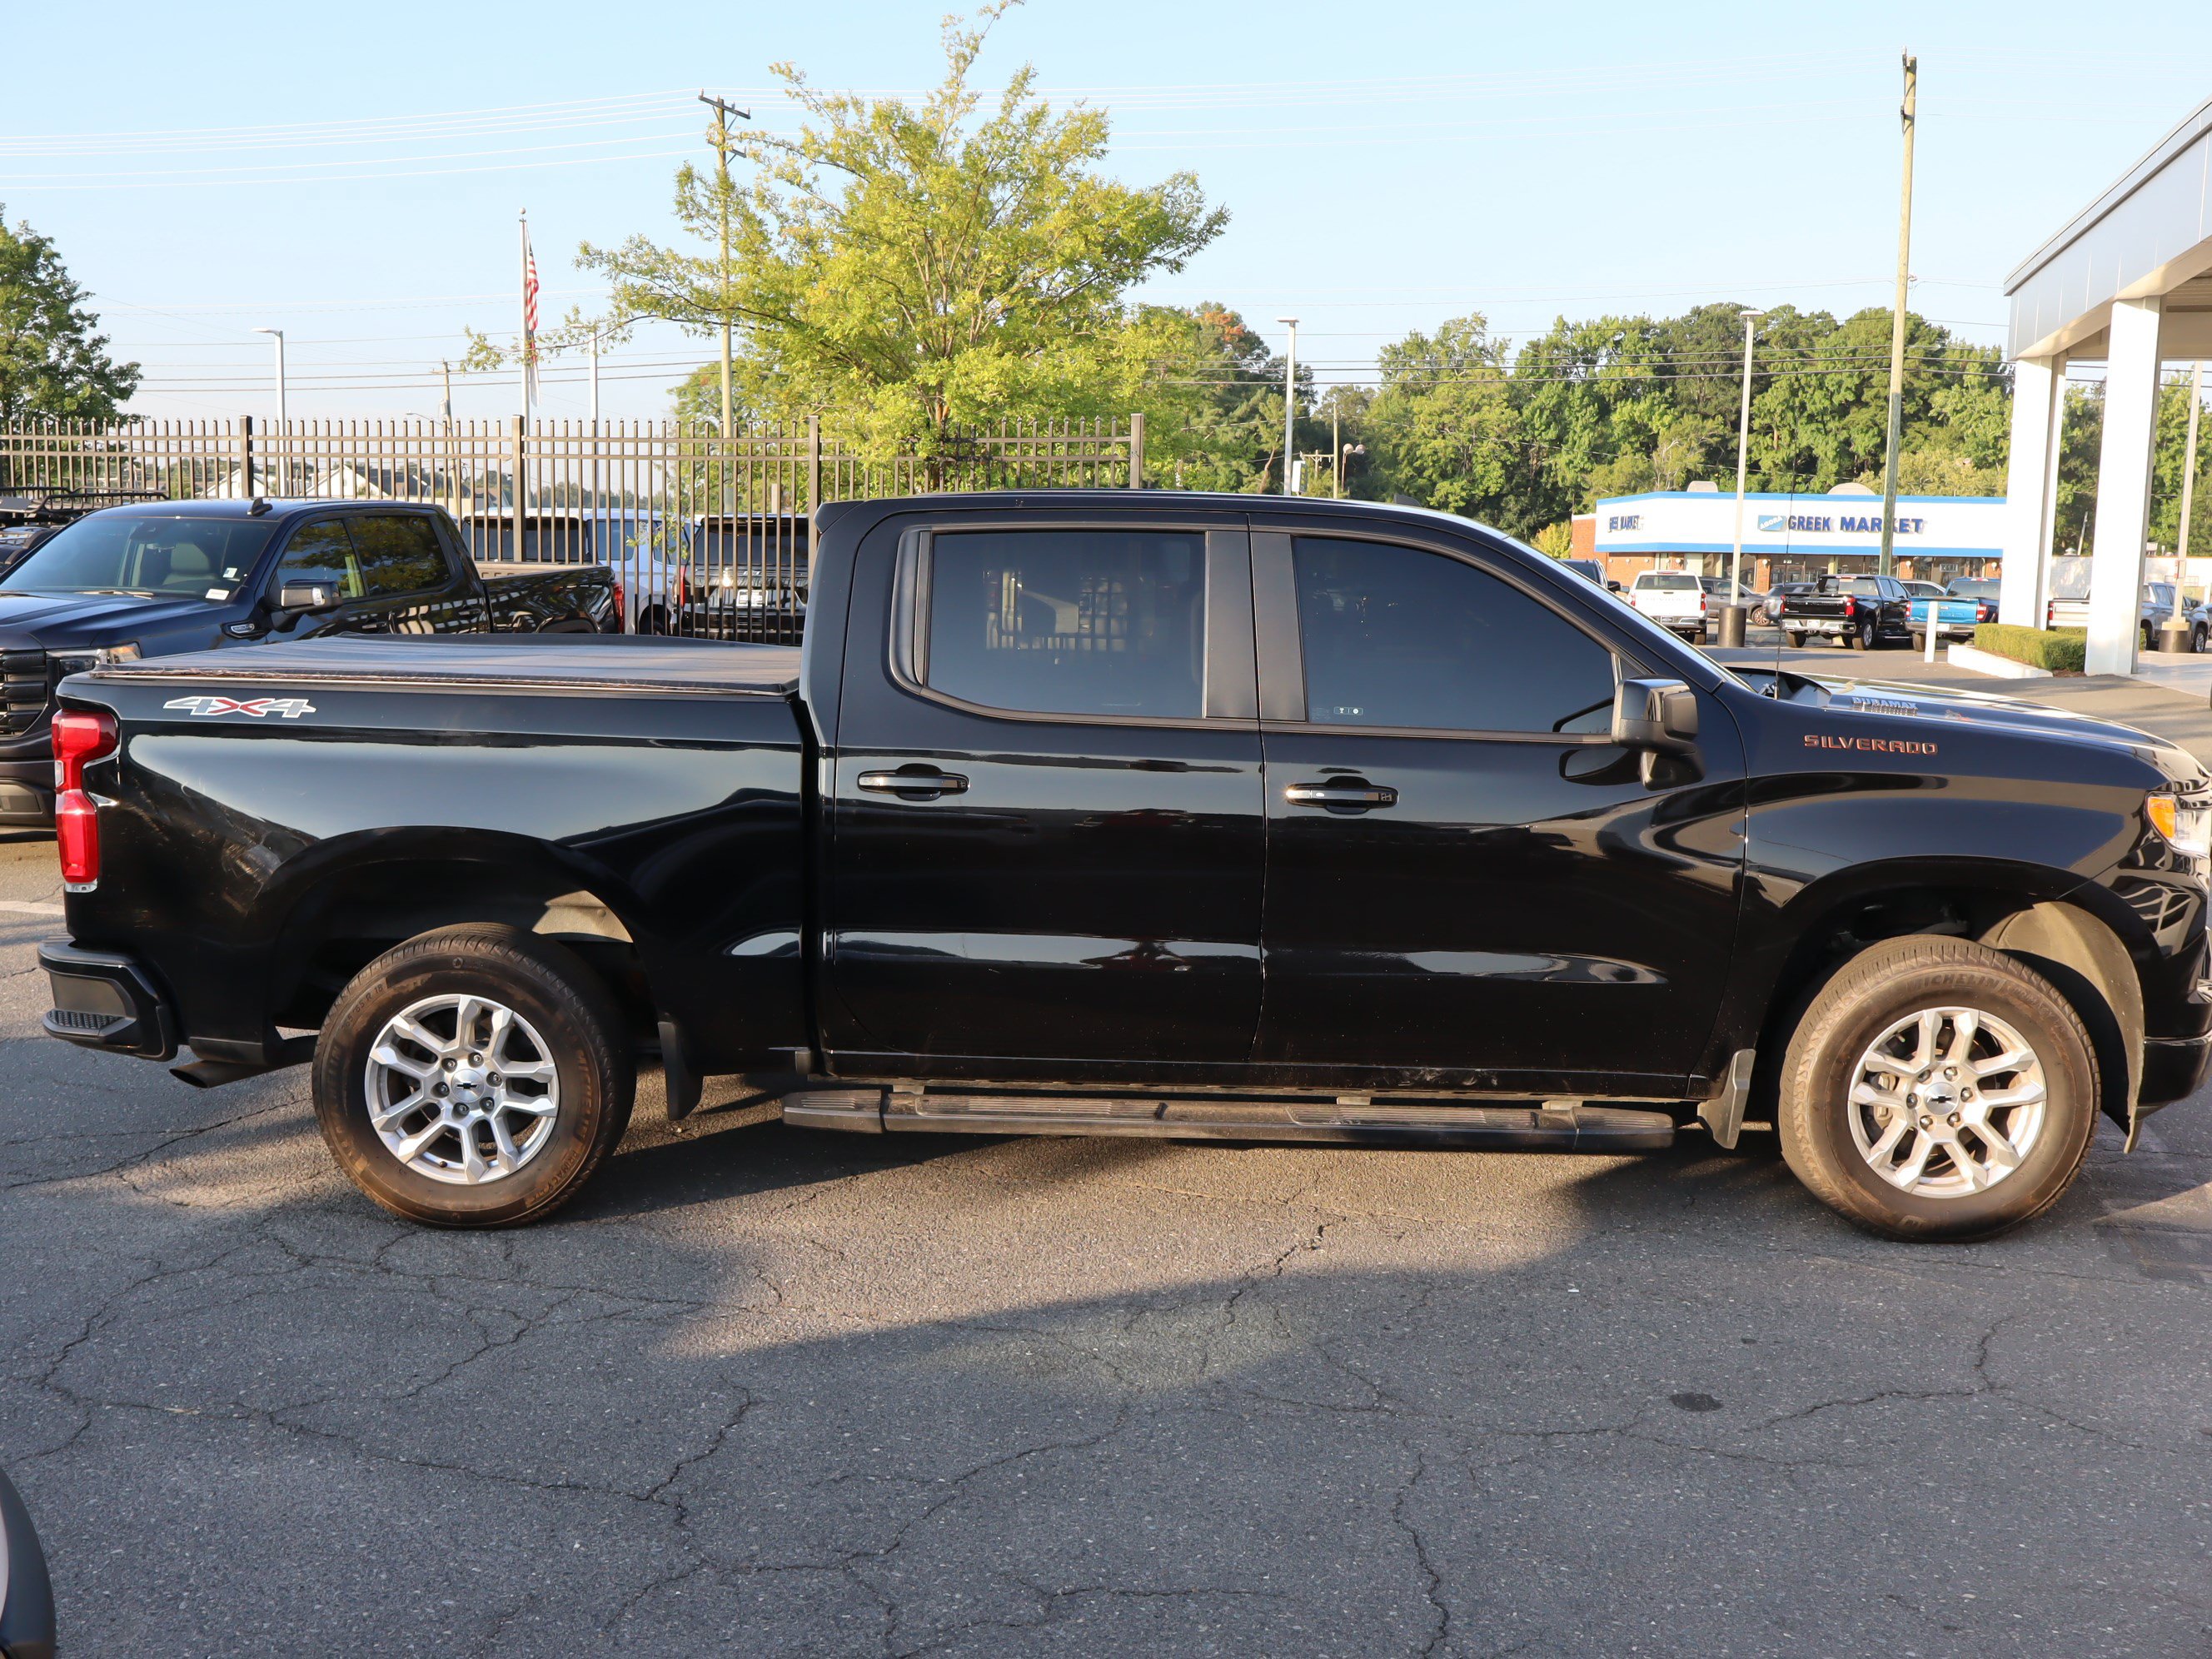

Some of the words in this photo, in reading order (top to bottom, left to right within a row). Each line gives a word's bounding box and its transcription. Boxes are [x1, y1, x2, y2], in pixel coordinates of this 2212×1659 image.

[1760, 516, 1783, 530] AGORA
[1788, 516, 1831, 531] GREEK
[1804, 735, 1939, 755] SILVERADO
[1906, 973, 2000, 992] MICHELIN
